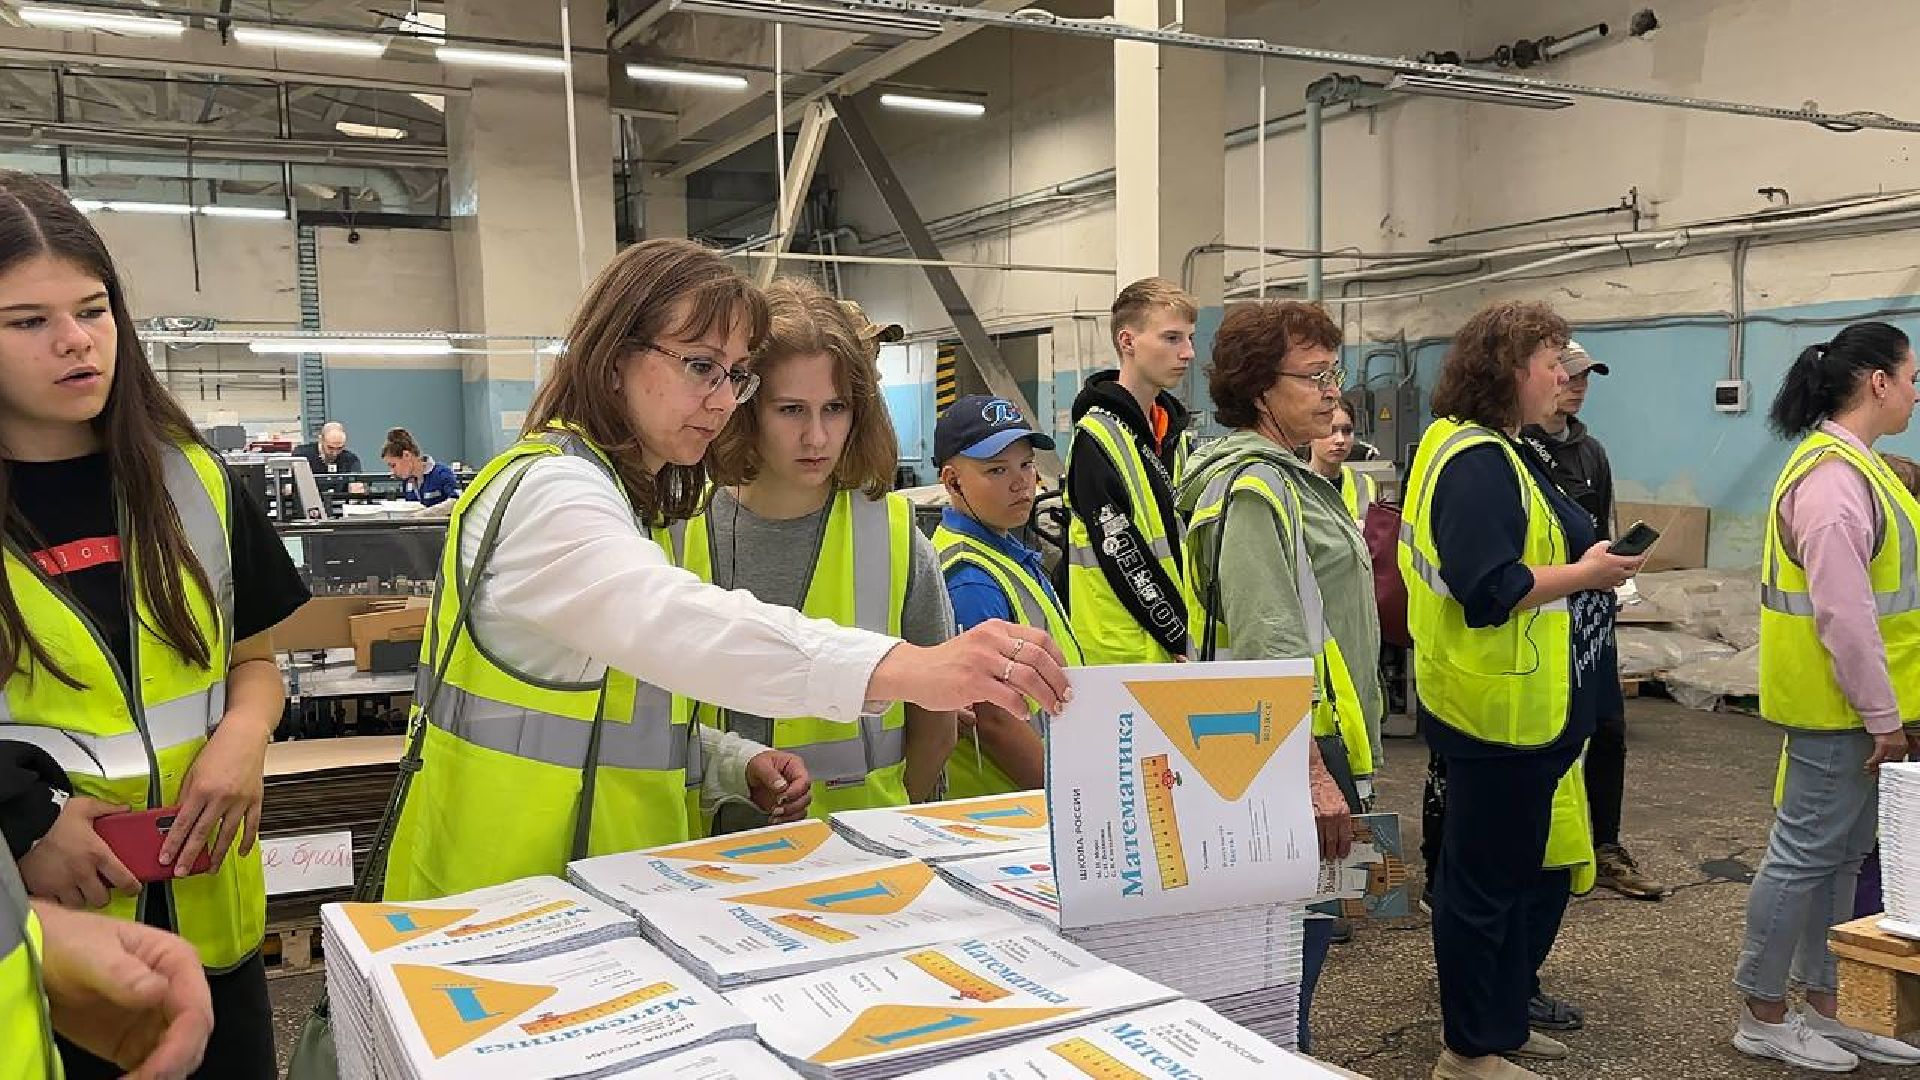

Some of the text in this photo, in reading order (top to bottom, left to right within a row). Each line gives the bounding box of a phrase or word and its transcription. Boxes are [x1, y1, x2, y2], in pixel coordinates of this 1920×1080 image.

[1188, 700, 1262, 750] 1
[1073, 788, 1088, 881] ШКОЛА РОССИИ
[1118, 711, 1144, 898] Математика
[953, 939, 1069, 1003] Математика
